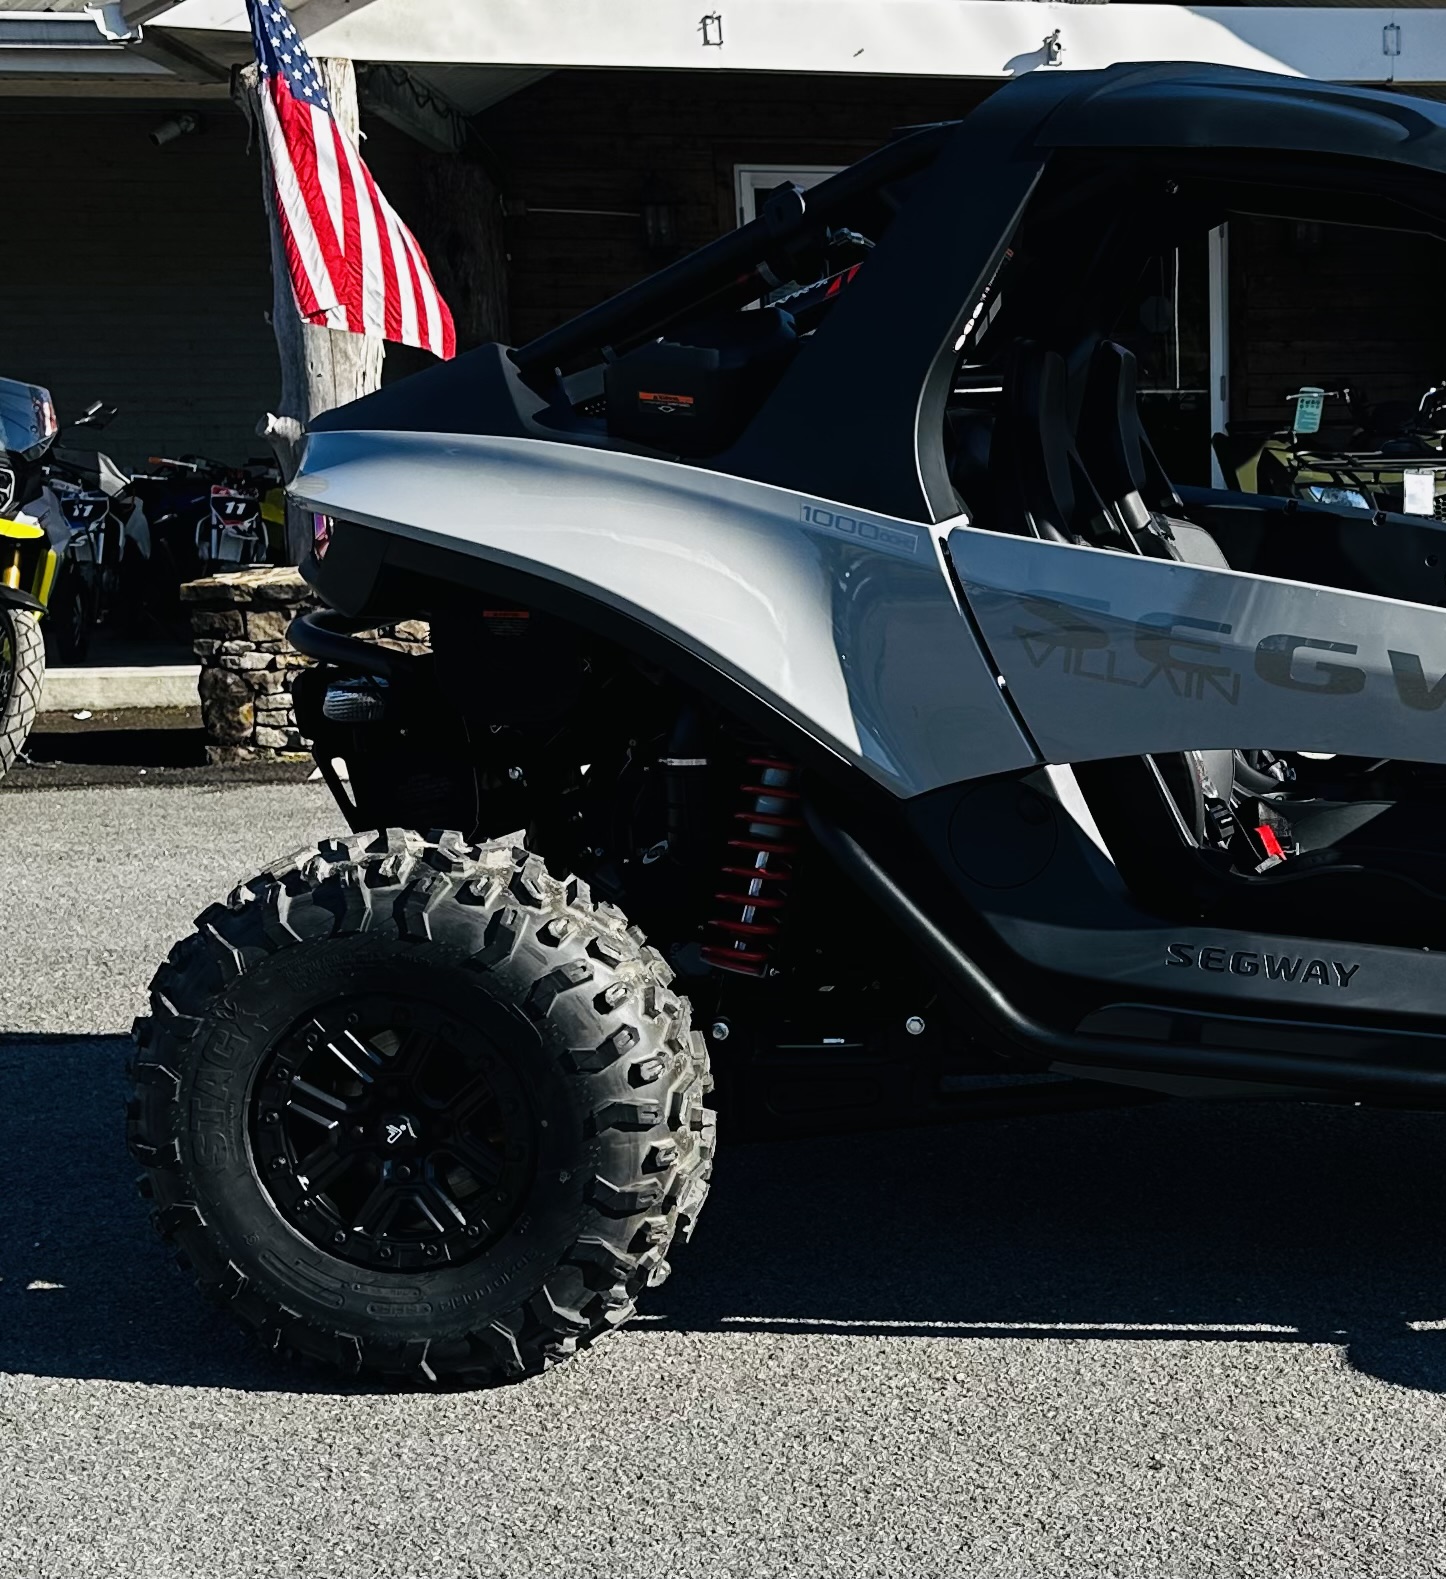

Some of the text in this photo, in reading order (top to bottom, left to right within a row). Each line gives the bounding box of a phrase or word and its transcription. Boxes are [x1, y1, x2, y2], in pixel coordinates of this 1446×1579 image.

[802, 505, 879, 540] 1000
[1012, 625, 1242, 706] VILLAIN
[1164, 943, 1361, 990] SEGWAY
[189, 1027, 249, 1168] STAG
